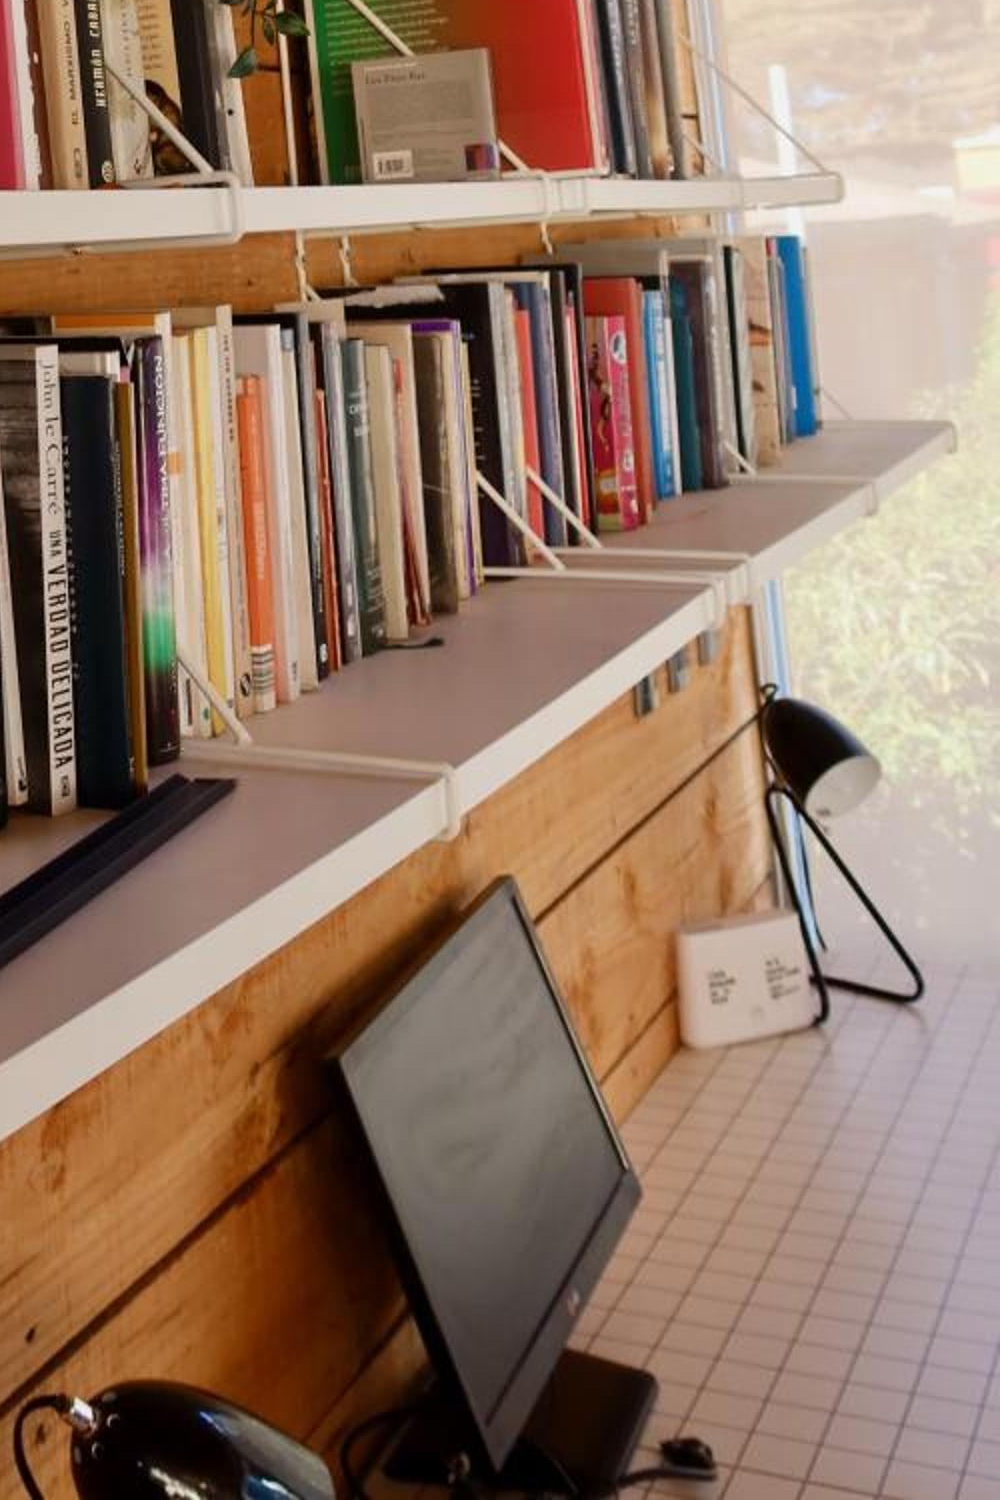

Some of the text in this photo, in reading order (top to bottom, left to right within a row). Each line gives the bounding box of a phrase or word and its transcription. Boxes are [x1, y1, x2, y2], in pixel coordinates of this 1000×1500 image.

[64, 21, 78, 100] MARXISMO
[71, 110, 80, 125] EL
[40, 360, 61, 517] John le Carré
[49, 530, 63, 558] UNA
[48, 563, 69, 654] VERDAD
[50, 659, 74, 769] DELICADA
